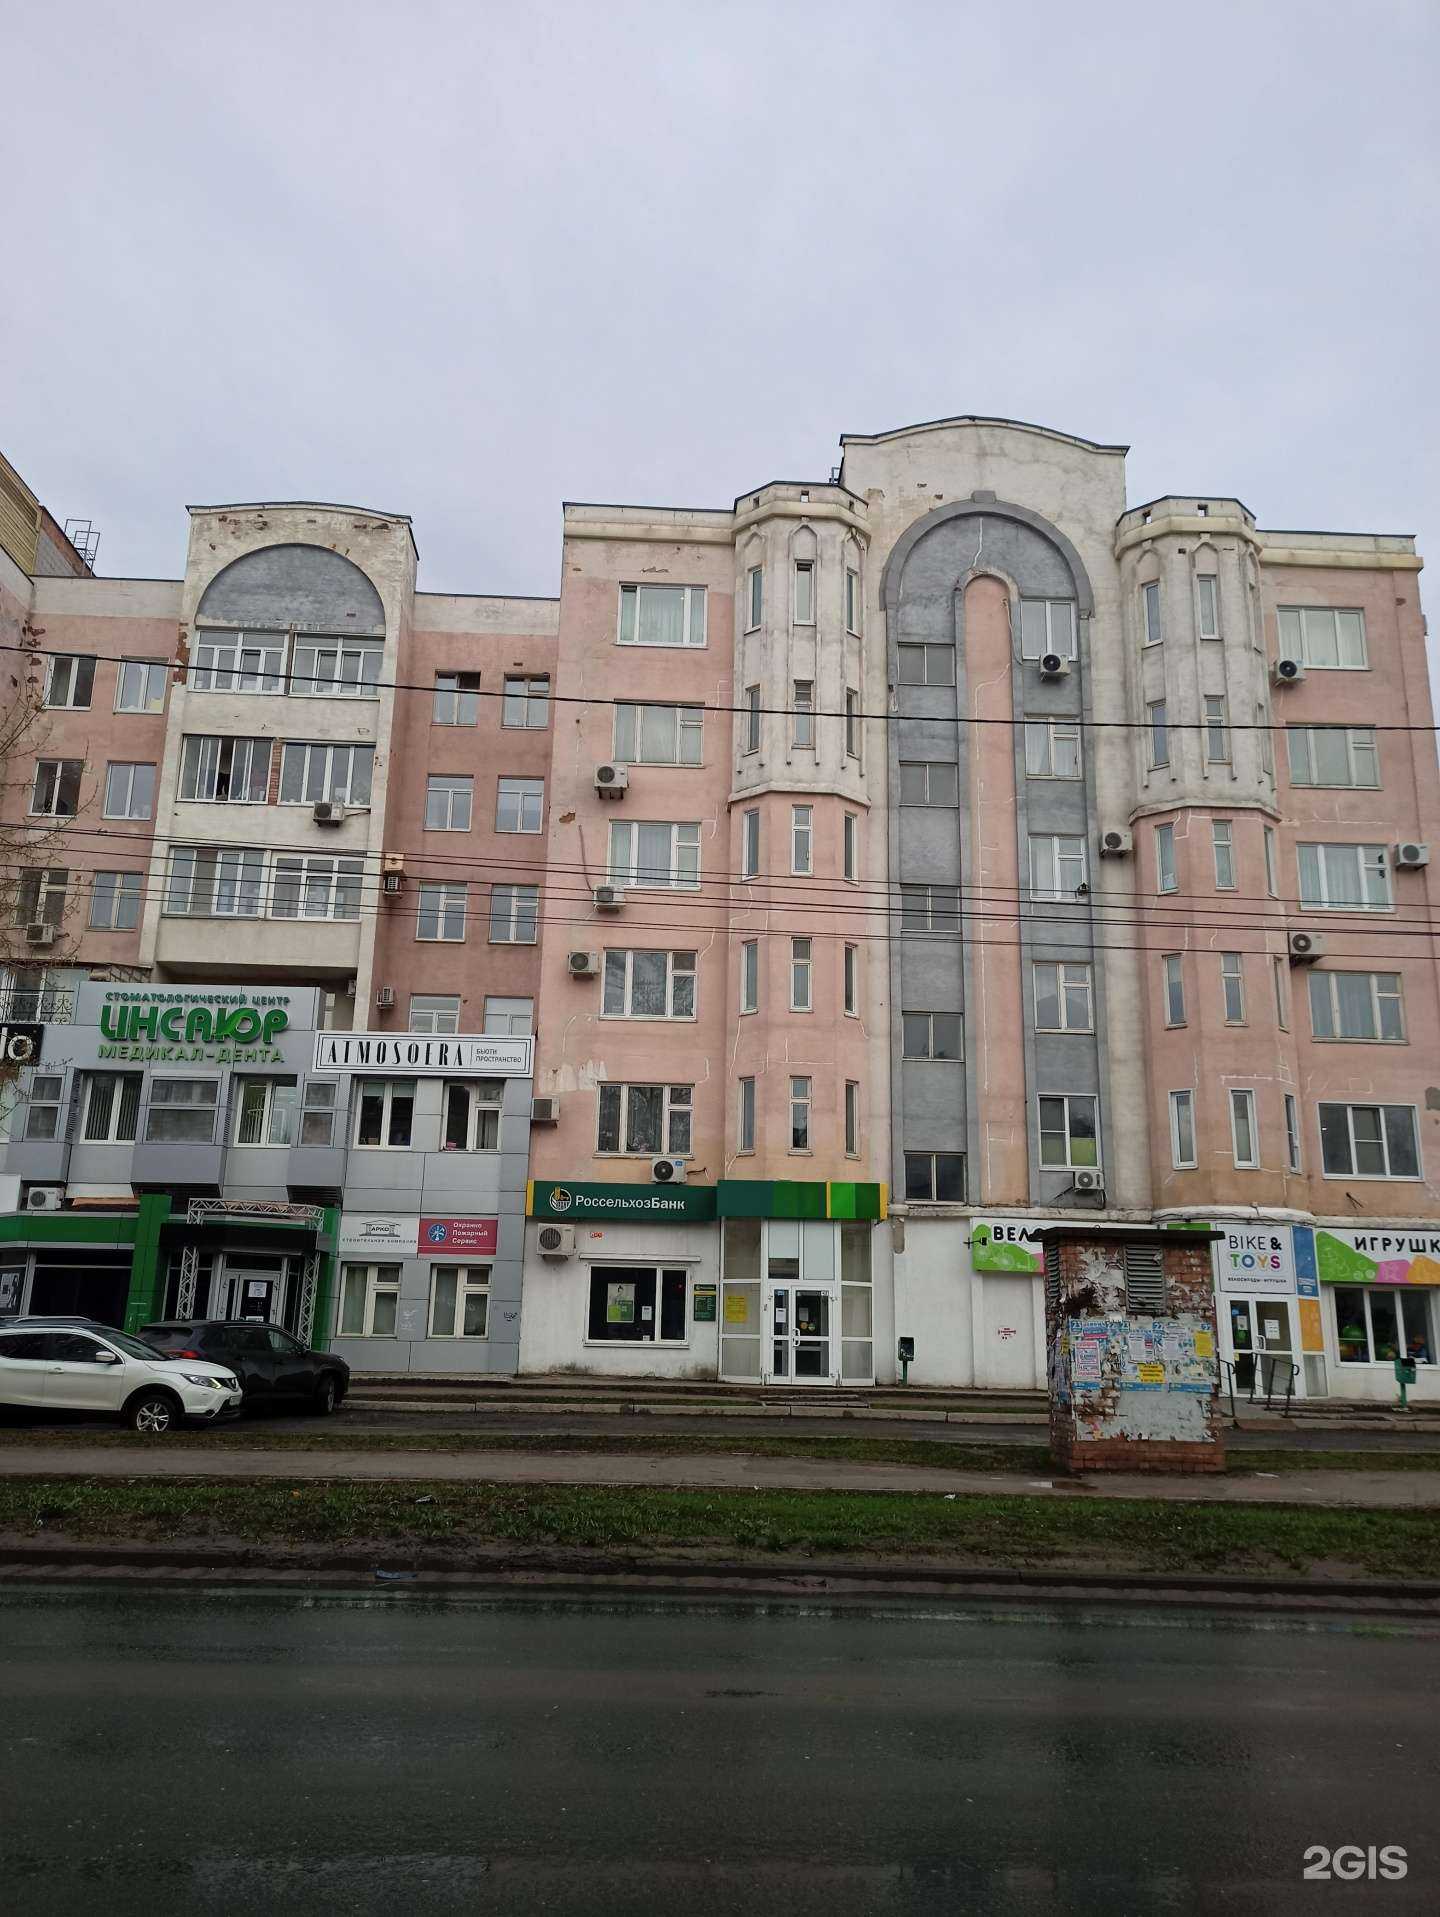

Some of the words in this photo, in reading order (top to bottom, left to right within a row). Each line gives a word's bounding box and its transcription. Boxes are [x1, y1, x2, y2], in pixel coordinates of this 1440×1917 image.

[105, 992, 247, 1005] СТОМАТОЛОГИЧЕСКИЙ
[252, 995, 290, 1006] ЦЕНТР
[97, 1045, 285, 1064] МЕДИКАЛ-ДЕНТА
[475, 1055, 522, 1063] ПРОСТРАНСТВО
[575, 1195, 686, 1211] РоссельхозБанк
[452, 1237, 478, 1245] Сервис
[993, 1226, 1044, 1241] ВЕЛ
[1229, 1235, 1266, 1250] BIKE
[1270, 1236, 1282, 1250] &
[1354, 1236, 1440, 1253] ИГРУШК
[1230, 1253, 1281, 1269] TOYS
